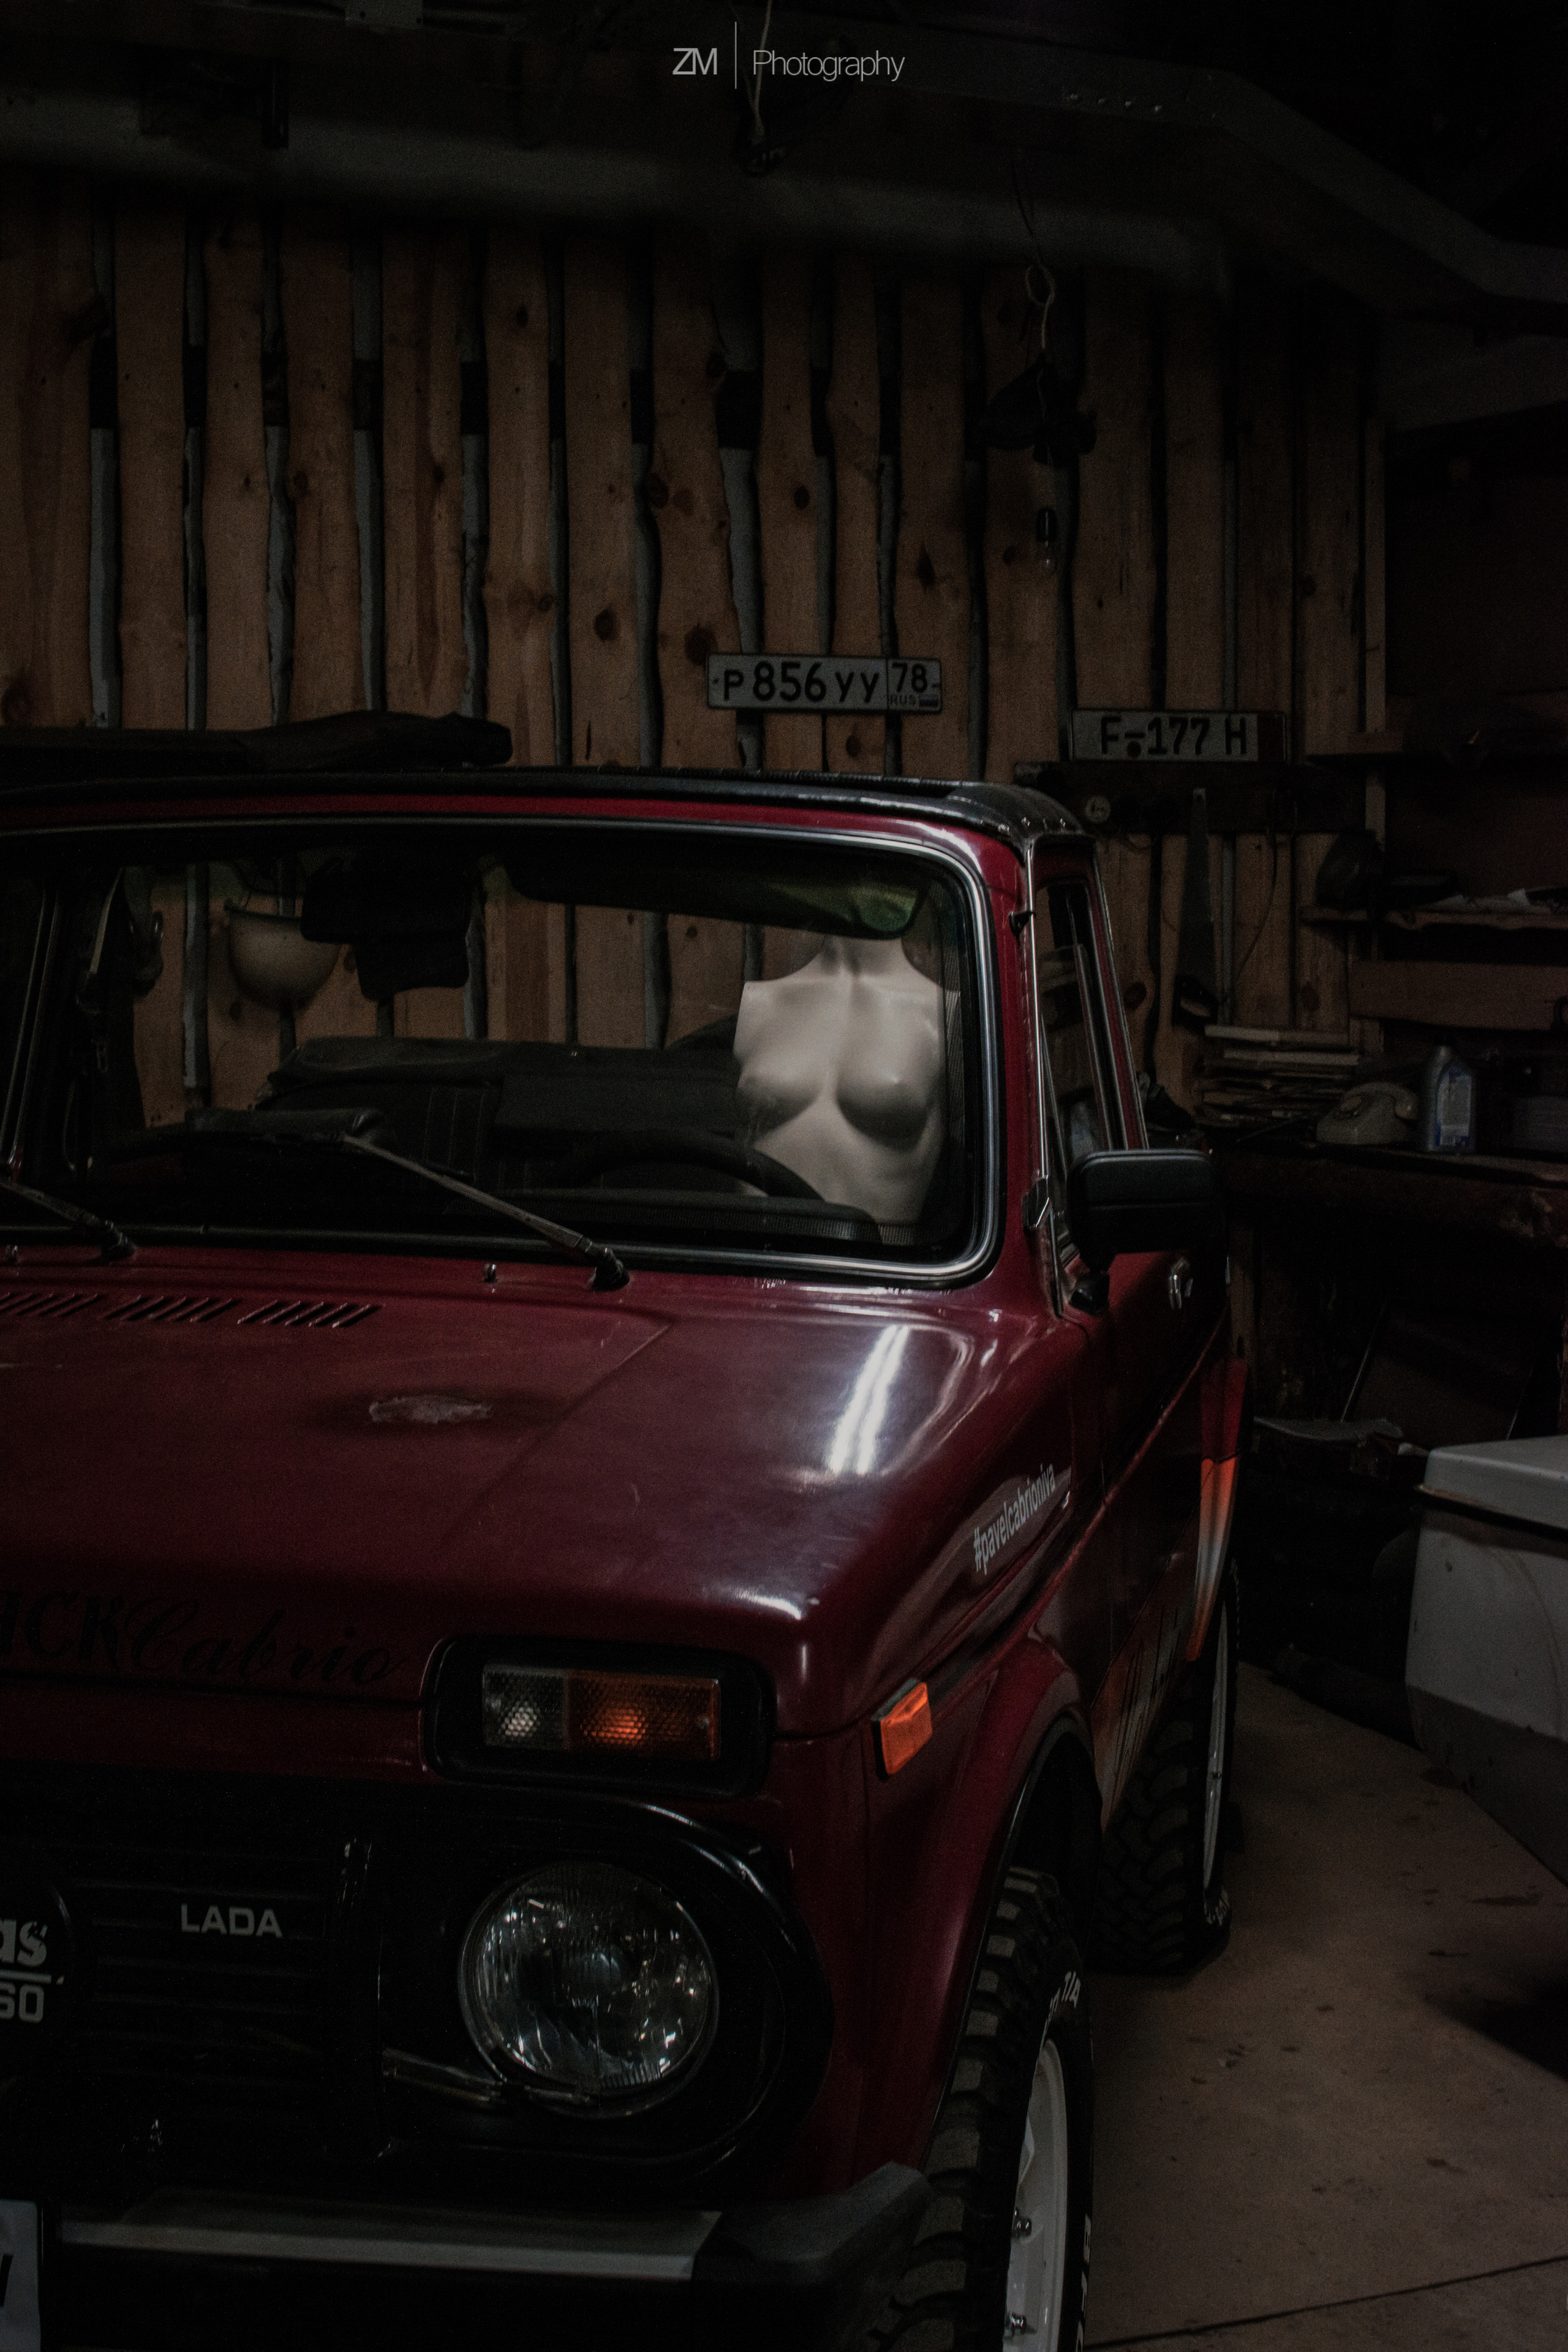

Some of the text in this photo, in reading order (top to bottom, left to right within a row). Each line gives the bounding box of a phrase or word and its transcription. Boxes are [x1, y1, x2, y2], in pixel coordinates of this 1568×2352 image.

[892, 662, 928, 693] 78
[973, 1463, 1056, 1575] #pavelcabrioniva
[181, 1903, 283, 1939] LADA
